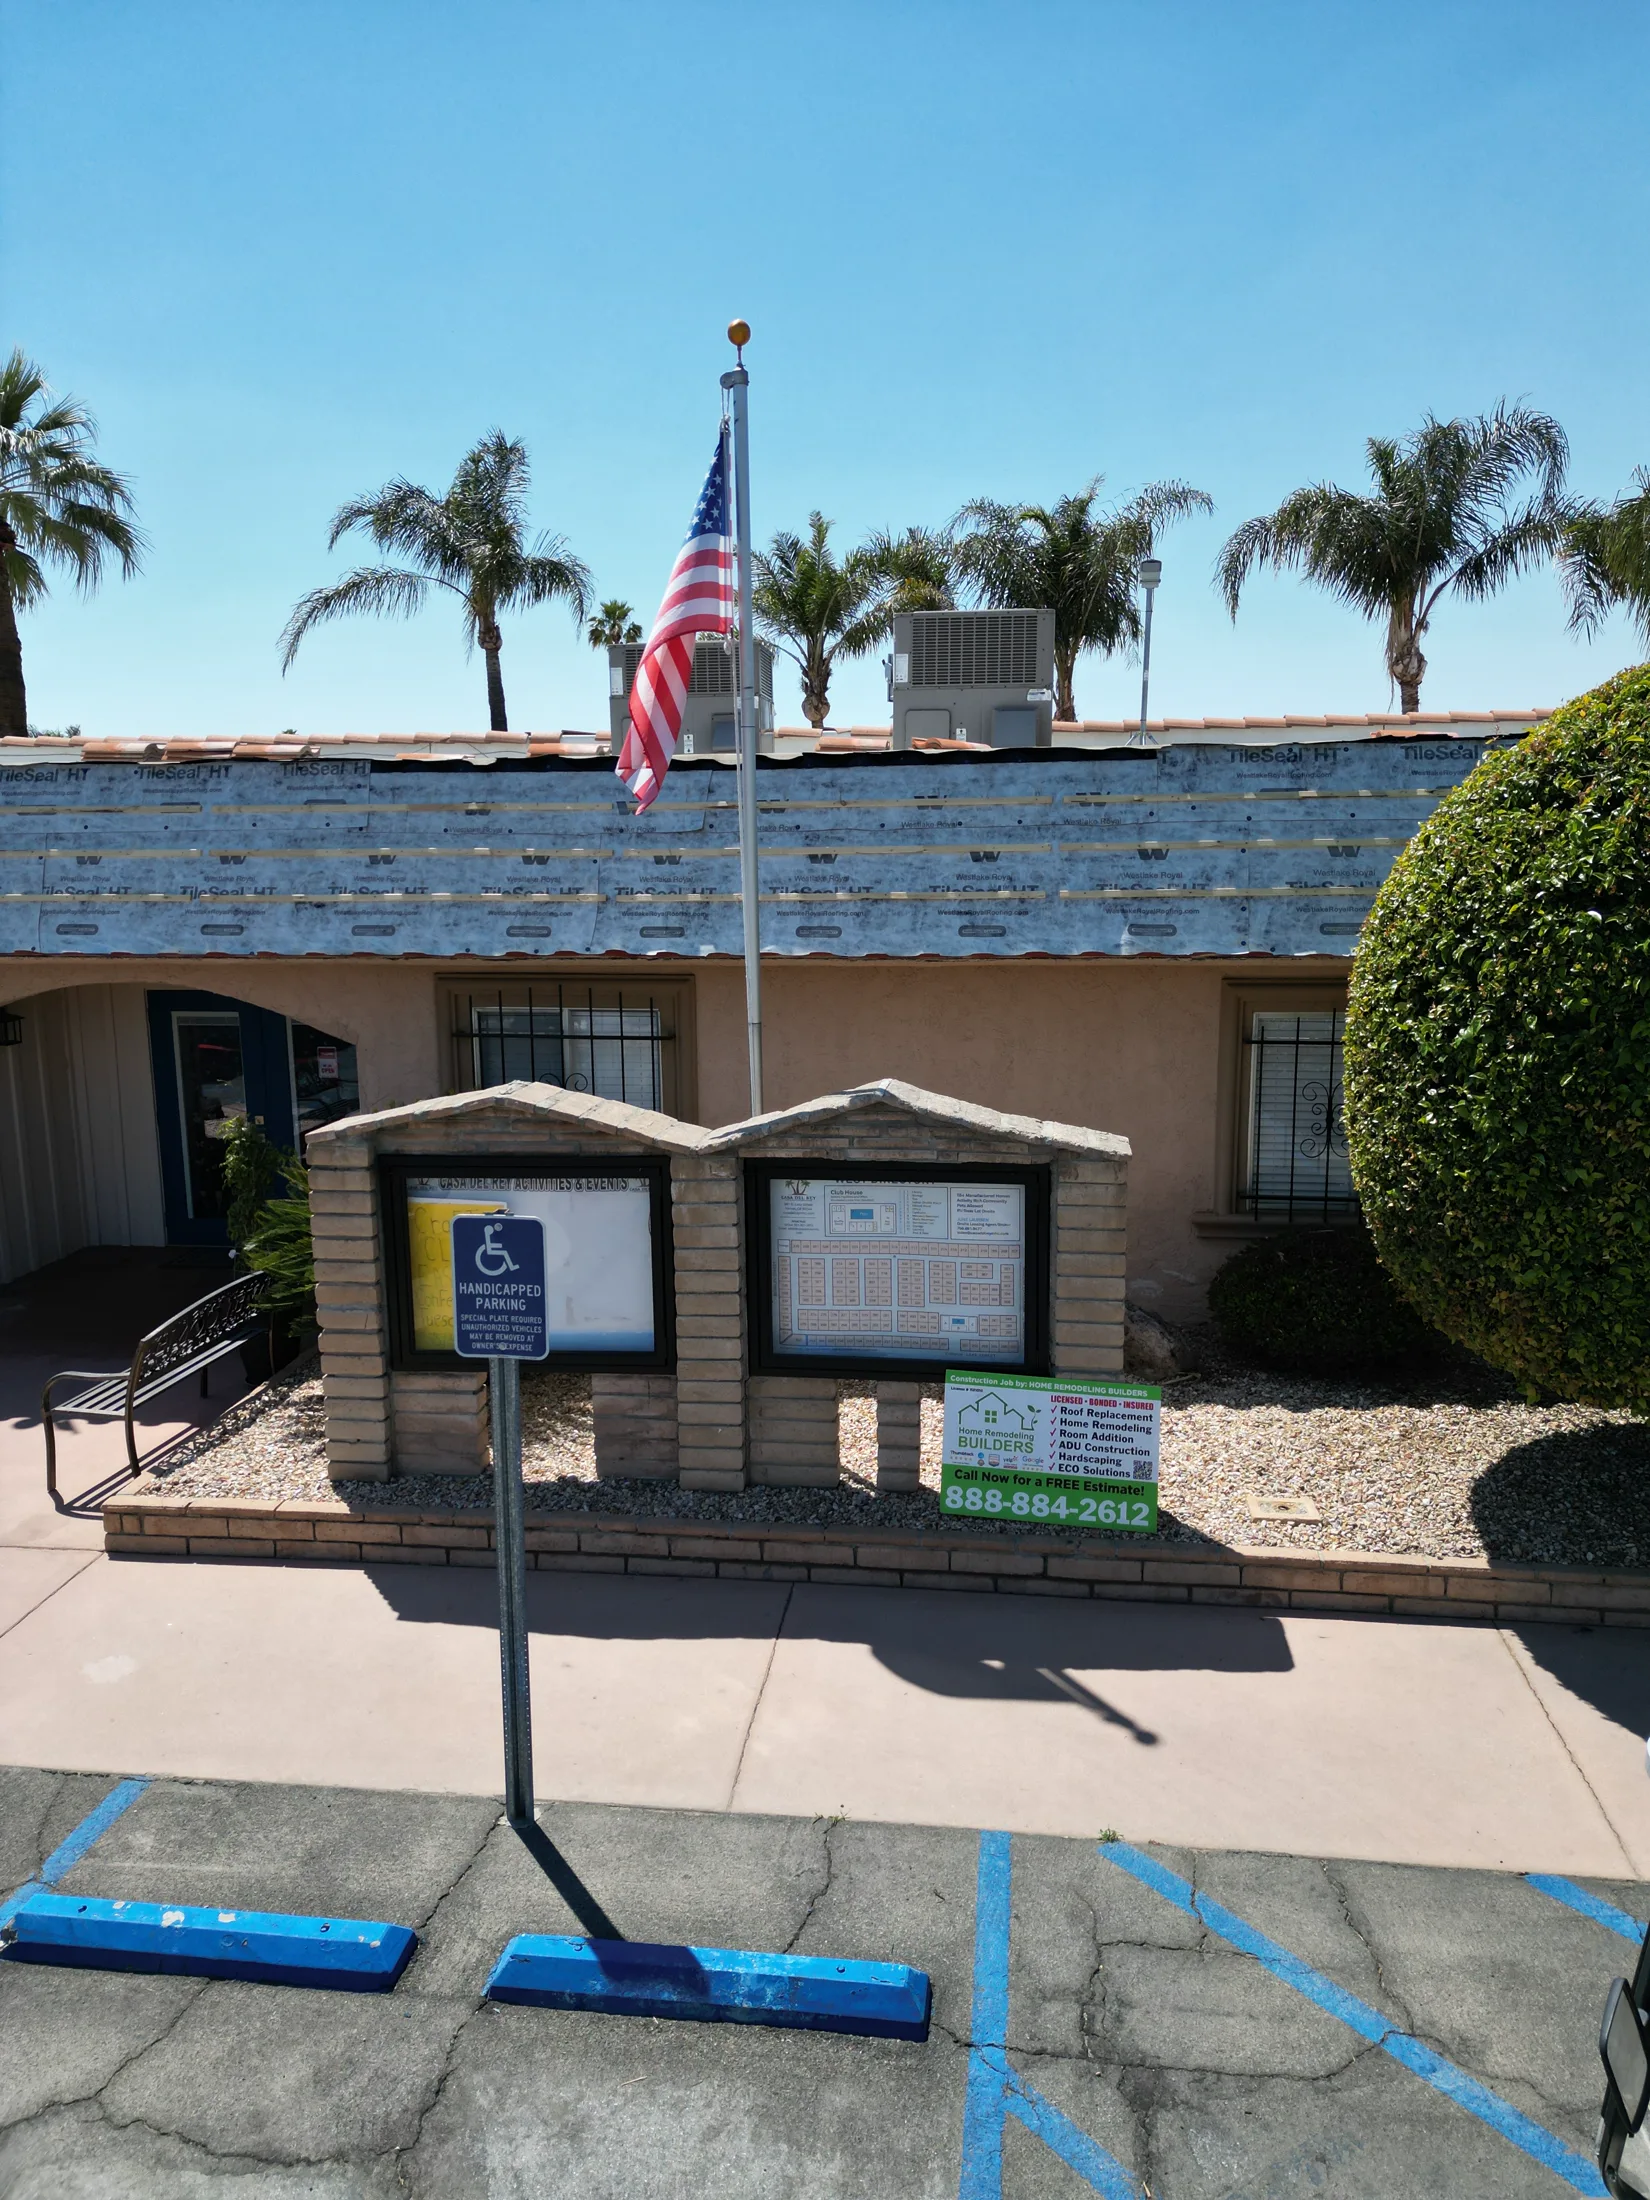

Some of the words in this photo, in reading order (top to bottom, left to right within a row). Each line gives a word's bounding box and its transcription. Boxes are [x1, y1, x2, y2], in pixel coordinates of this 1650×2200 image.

[1314, 746, 1341, 762] HT
[67, 768, 91, 781] HT
[209, 765, 232, 779] HT
[354, 761, 369, 775] H
[1296, 906, 1371, 914] WestlakeRoyalRoofi
[440, 1178, 467, 1190] CASA
[470, 1178, 490, 1191] DEL
[492, 1178, 512, 1191] REY
[514, 1178, 572, 1192] ACTIVITIES
[575, 1178, 583, 1192] &
[586, 1178, 629, 1192] EVENTS
[460, 1282, 541, 1297] HANDICAPPED
[476, 1297, 526, 1311] PARKING
[511, 1316, 542, 1324] REQUIRED
[461, 1323, 510, 1332] UNAUTHORIZED
[512, 1325, 542, 1333] VEHICLES
[496, 1334, 525, 1342] REMOVED
[472, 1342, 500, 1350] OWNER'S
[504, 1343, 533, 1351] EXPENSE
[950, 1375, 998, 1386] Construction
[1015, 1380, 1028, 1388] by:
[1029, 1381, 1052, 1389] HOME
[1054, 1383, 1107, 1394] REMODELING
[1108, 1388, 1148, 1397] BUILDERS
[1050, 1395, 1083, 1405] LICENSED
[1089, 1398, 1117, 1408] BONDED
[1123, 1401, 1154, 1411] INSURED
[1060, 1406, 1084, 1416] Roof
[1087, 1408, 1153, 1422] Replacement
[1060, 1418, 1089, 1428] Home
[1092, 1420, 1152, 1435] Remodeling
[958, 1427, 982, 1436] Home
[985, 1429, 1035, 1442] Remodeling
[1059, 1429, 1088, 1440] Room
[1091, 1432, 1134, 1444] Addition
[958, 1436, 1034, 1454] BUILDERS
[1058, 1441, 1081, 1450] ADU
[1085, 1443, 1150, 1457] Construction
[1022, 1455, 1044, 1464] Google
[1058, 1452, 1122, 1467] Hardscaping
[1058, 1463, 1079, 1473] ECO
[1083, 1465, 1131, 1478] Solutions
[954, 1468, 978, 1481] Call
[981, 1473, 1009, 1484] Now
[1013, 1475, 1032, 1486] for
[1035, 1479, 1042, 1487] a
[1046, 1477, 1080, 1490] FREE
[1083, 1480, 1145, 1496] Estimate!
[945, 1485, 1150, 1527] 888-884-2612
